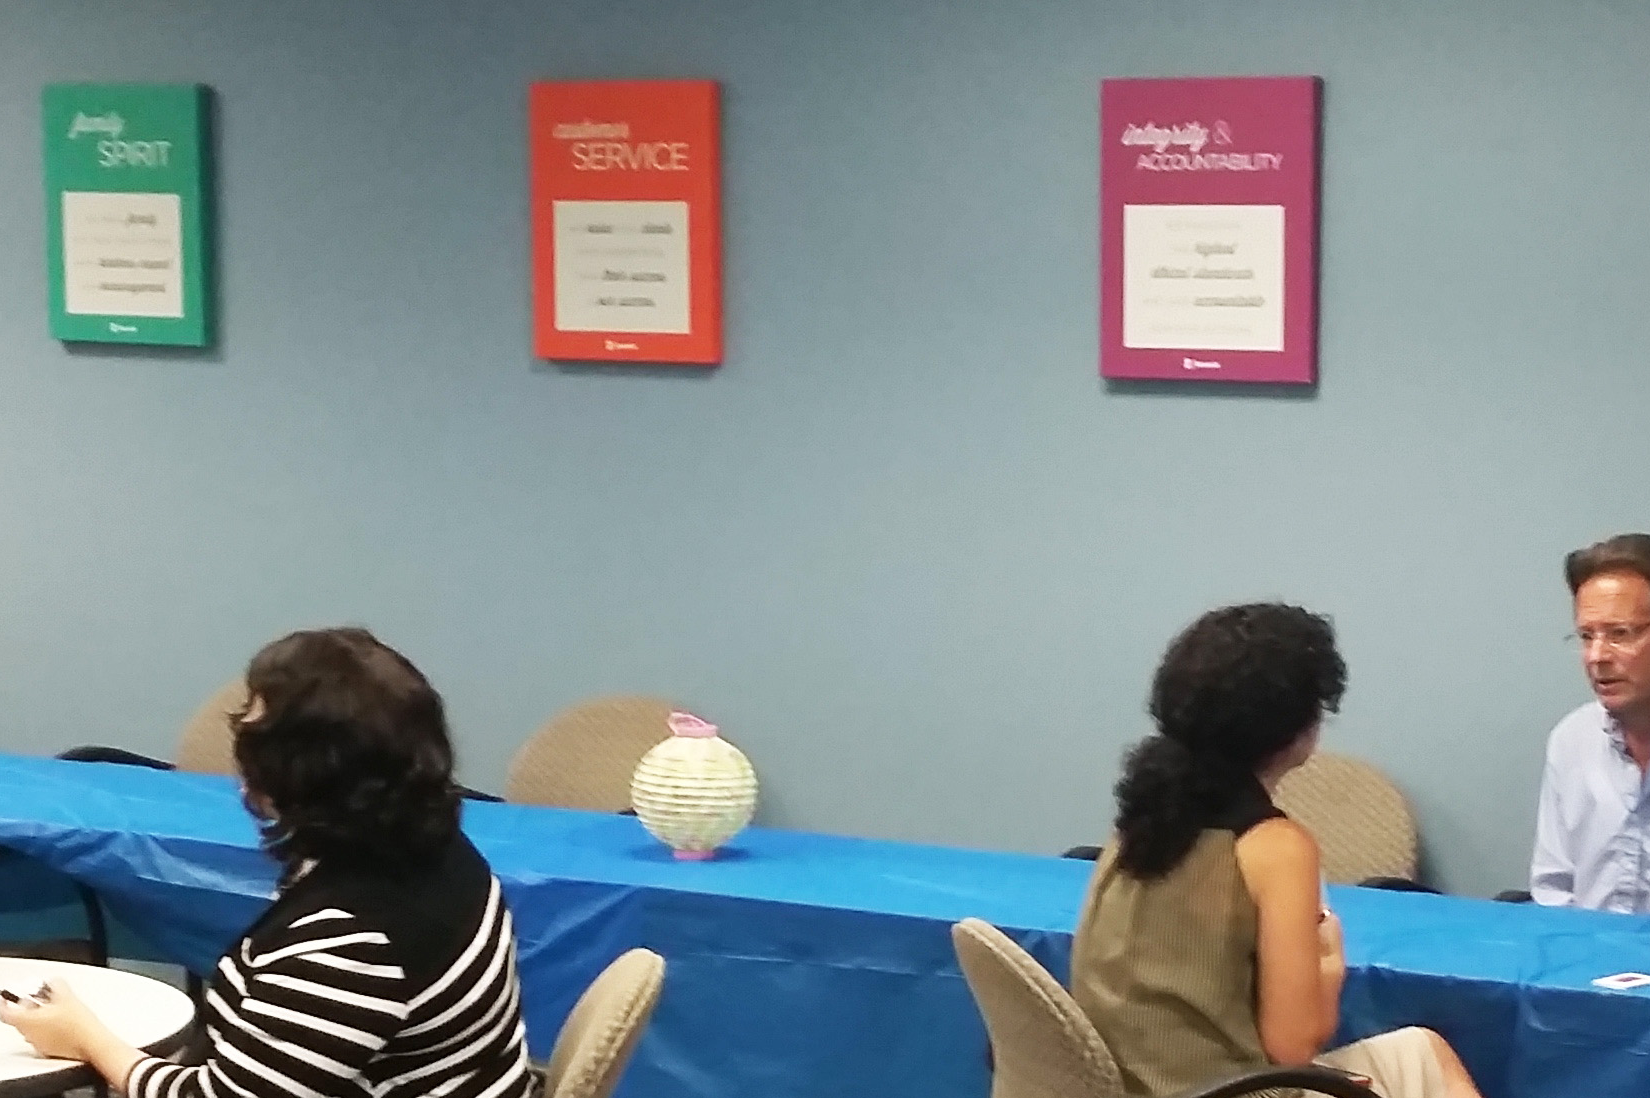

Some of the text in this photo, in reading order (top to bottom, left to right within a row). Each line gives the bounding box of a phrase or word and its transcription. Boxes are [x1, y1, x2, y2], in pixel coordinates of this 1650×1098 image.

[1212, 119, 1233, 145] &
[98, 140, 173, 168] SPIRIT
[572, 141, 691, 171] SERVICE
[1135, 152, 1284, 172] ACCOUNTABILITY
